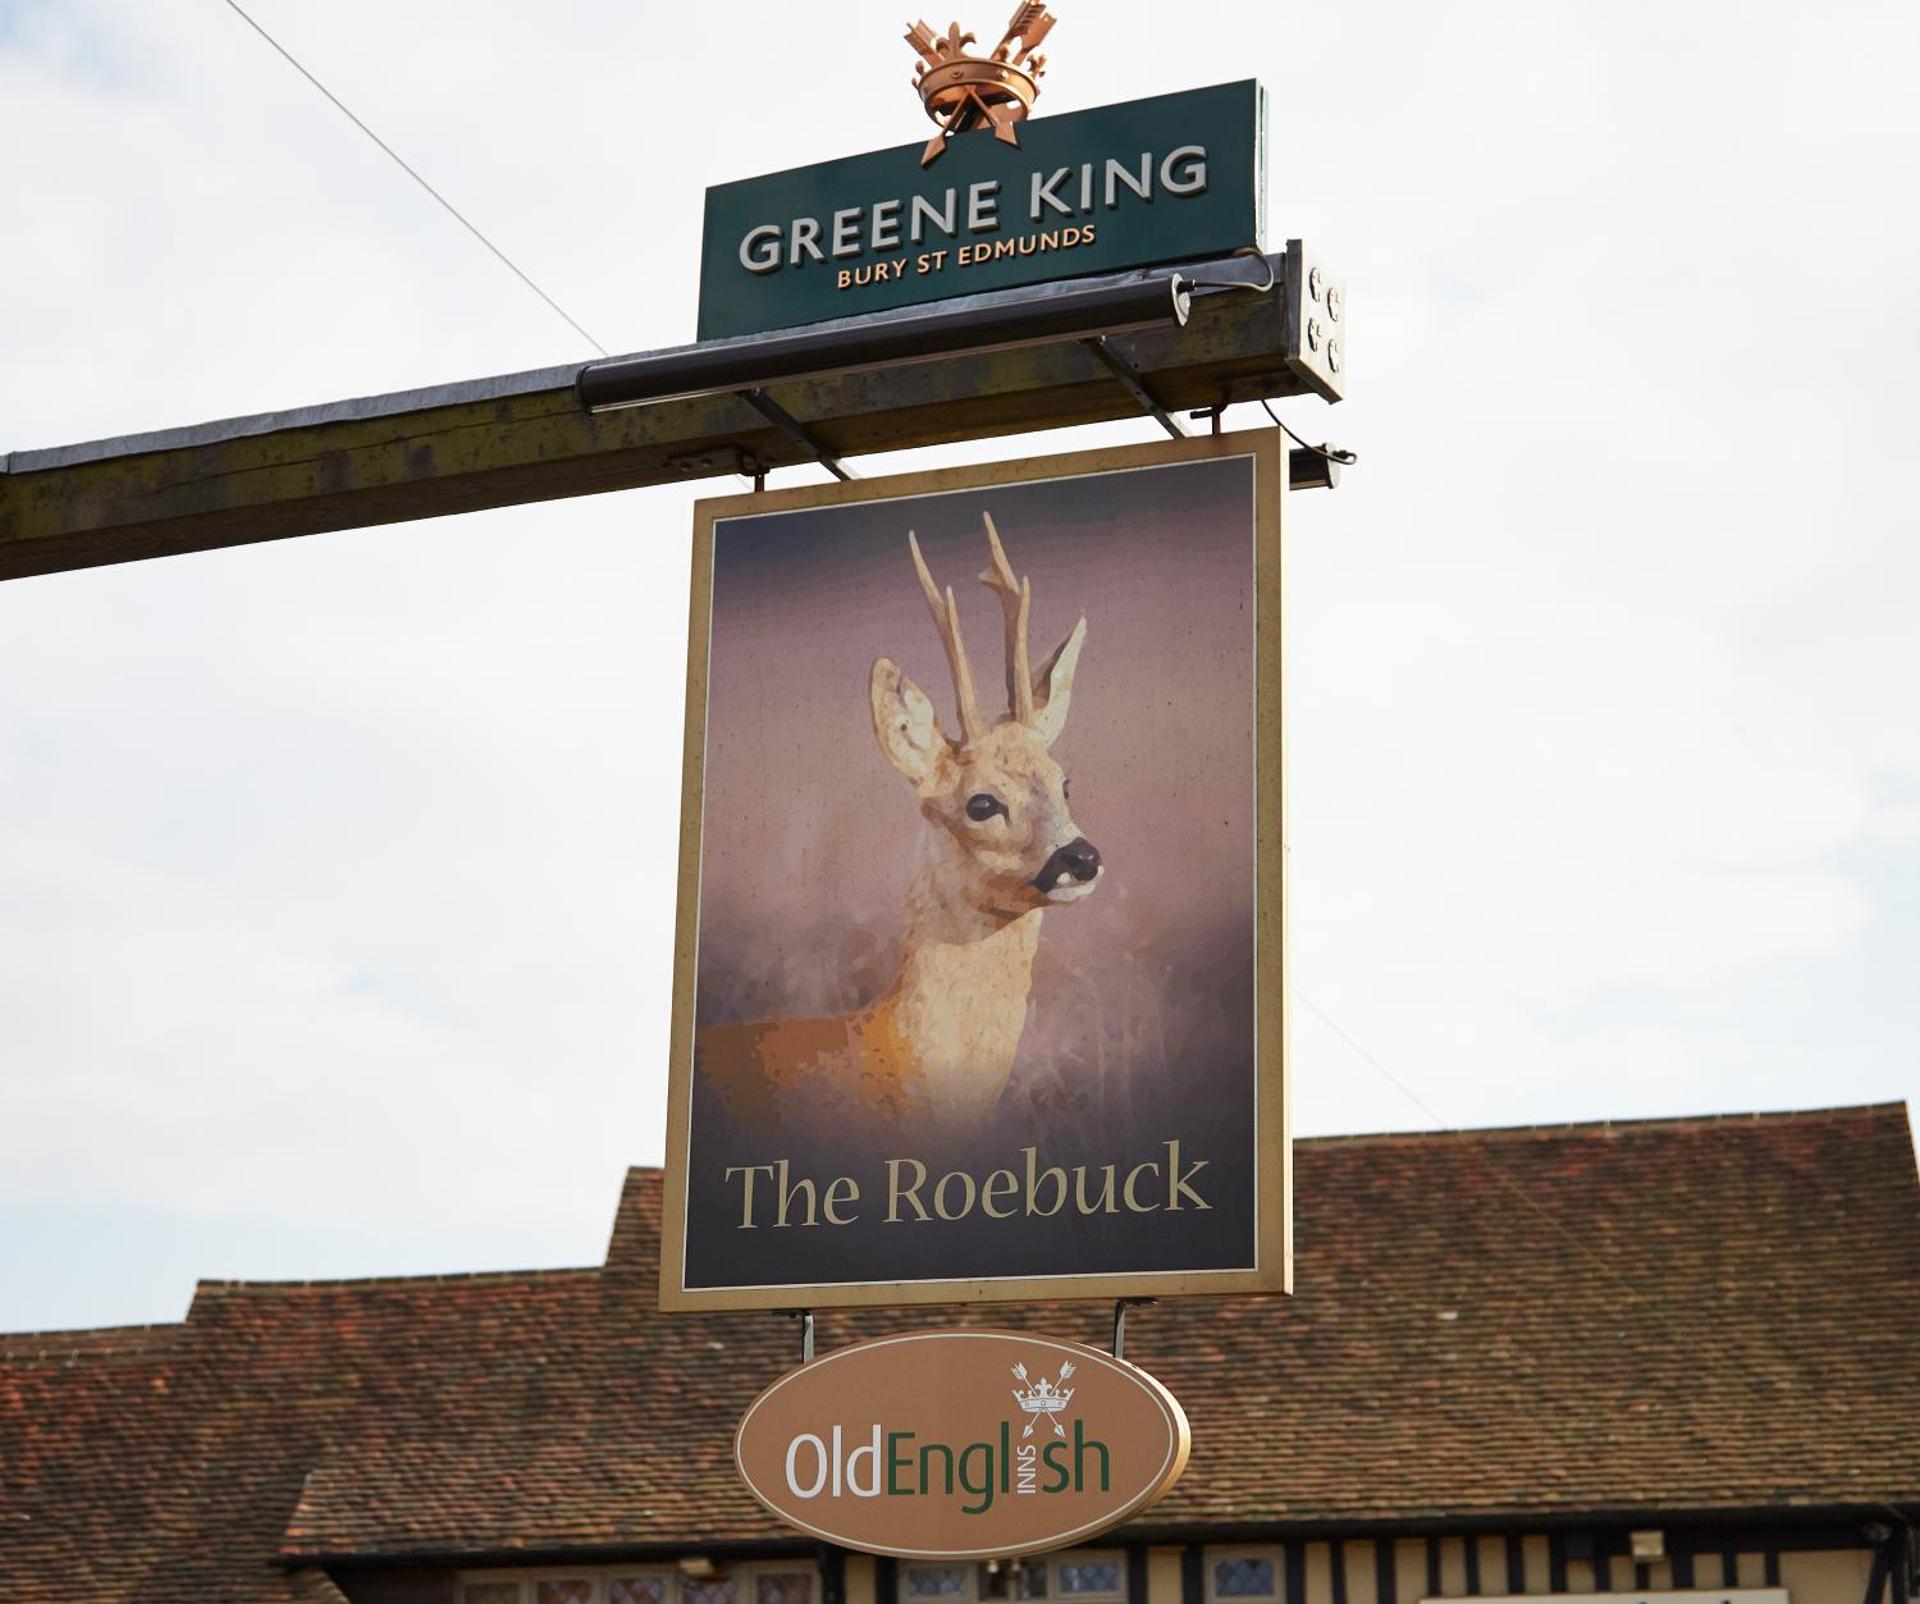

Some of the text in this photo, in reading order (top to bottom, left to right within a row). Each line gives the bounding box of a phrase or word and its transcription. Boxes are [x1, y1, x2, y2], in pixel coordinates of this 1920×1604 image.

[738, 144, 1208, 275] GREENE KING
[836, 224, 1096, 290] BURY ST EDMUNDS
[725, 1140, 1213, 1230] The Roebuck
[1016, 1444, 1037, 1495] INNS
